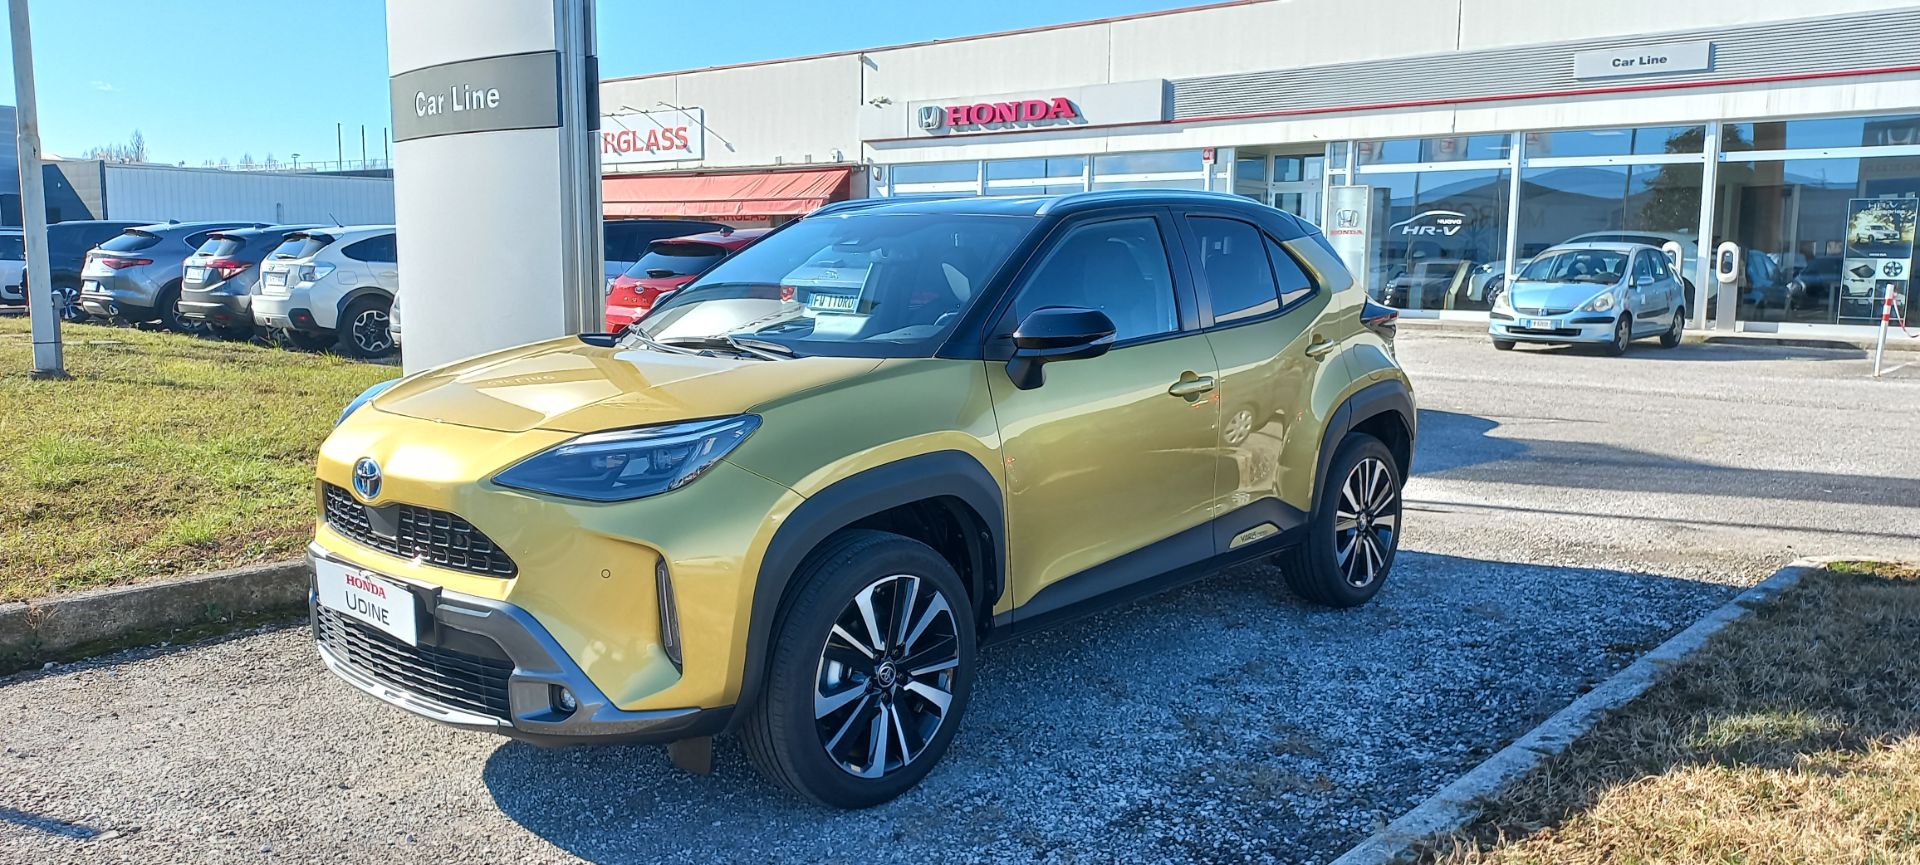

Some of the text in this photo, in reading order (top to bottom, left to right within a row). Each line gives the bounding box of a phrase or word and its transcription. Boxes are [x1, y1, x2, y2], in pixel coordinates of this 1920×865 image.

[1612, 56, 1668, 67] Car Line
[414, 84, 500, 117] Car Line
[945, 97, 1077, 126] HONDA
[601, 126, 688, 154] RGLASS
[1401, 225, 1461, 236] HR-V
[345, 573, 386, 600] HONDA
[345, 590, 390, 626] UDINE
